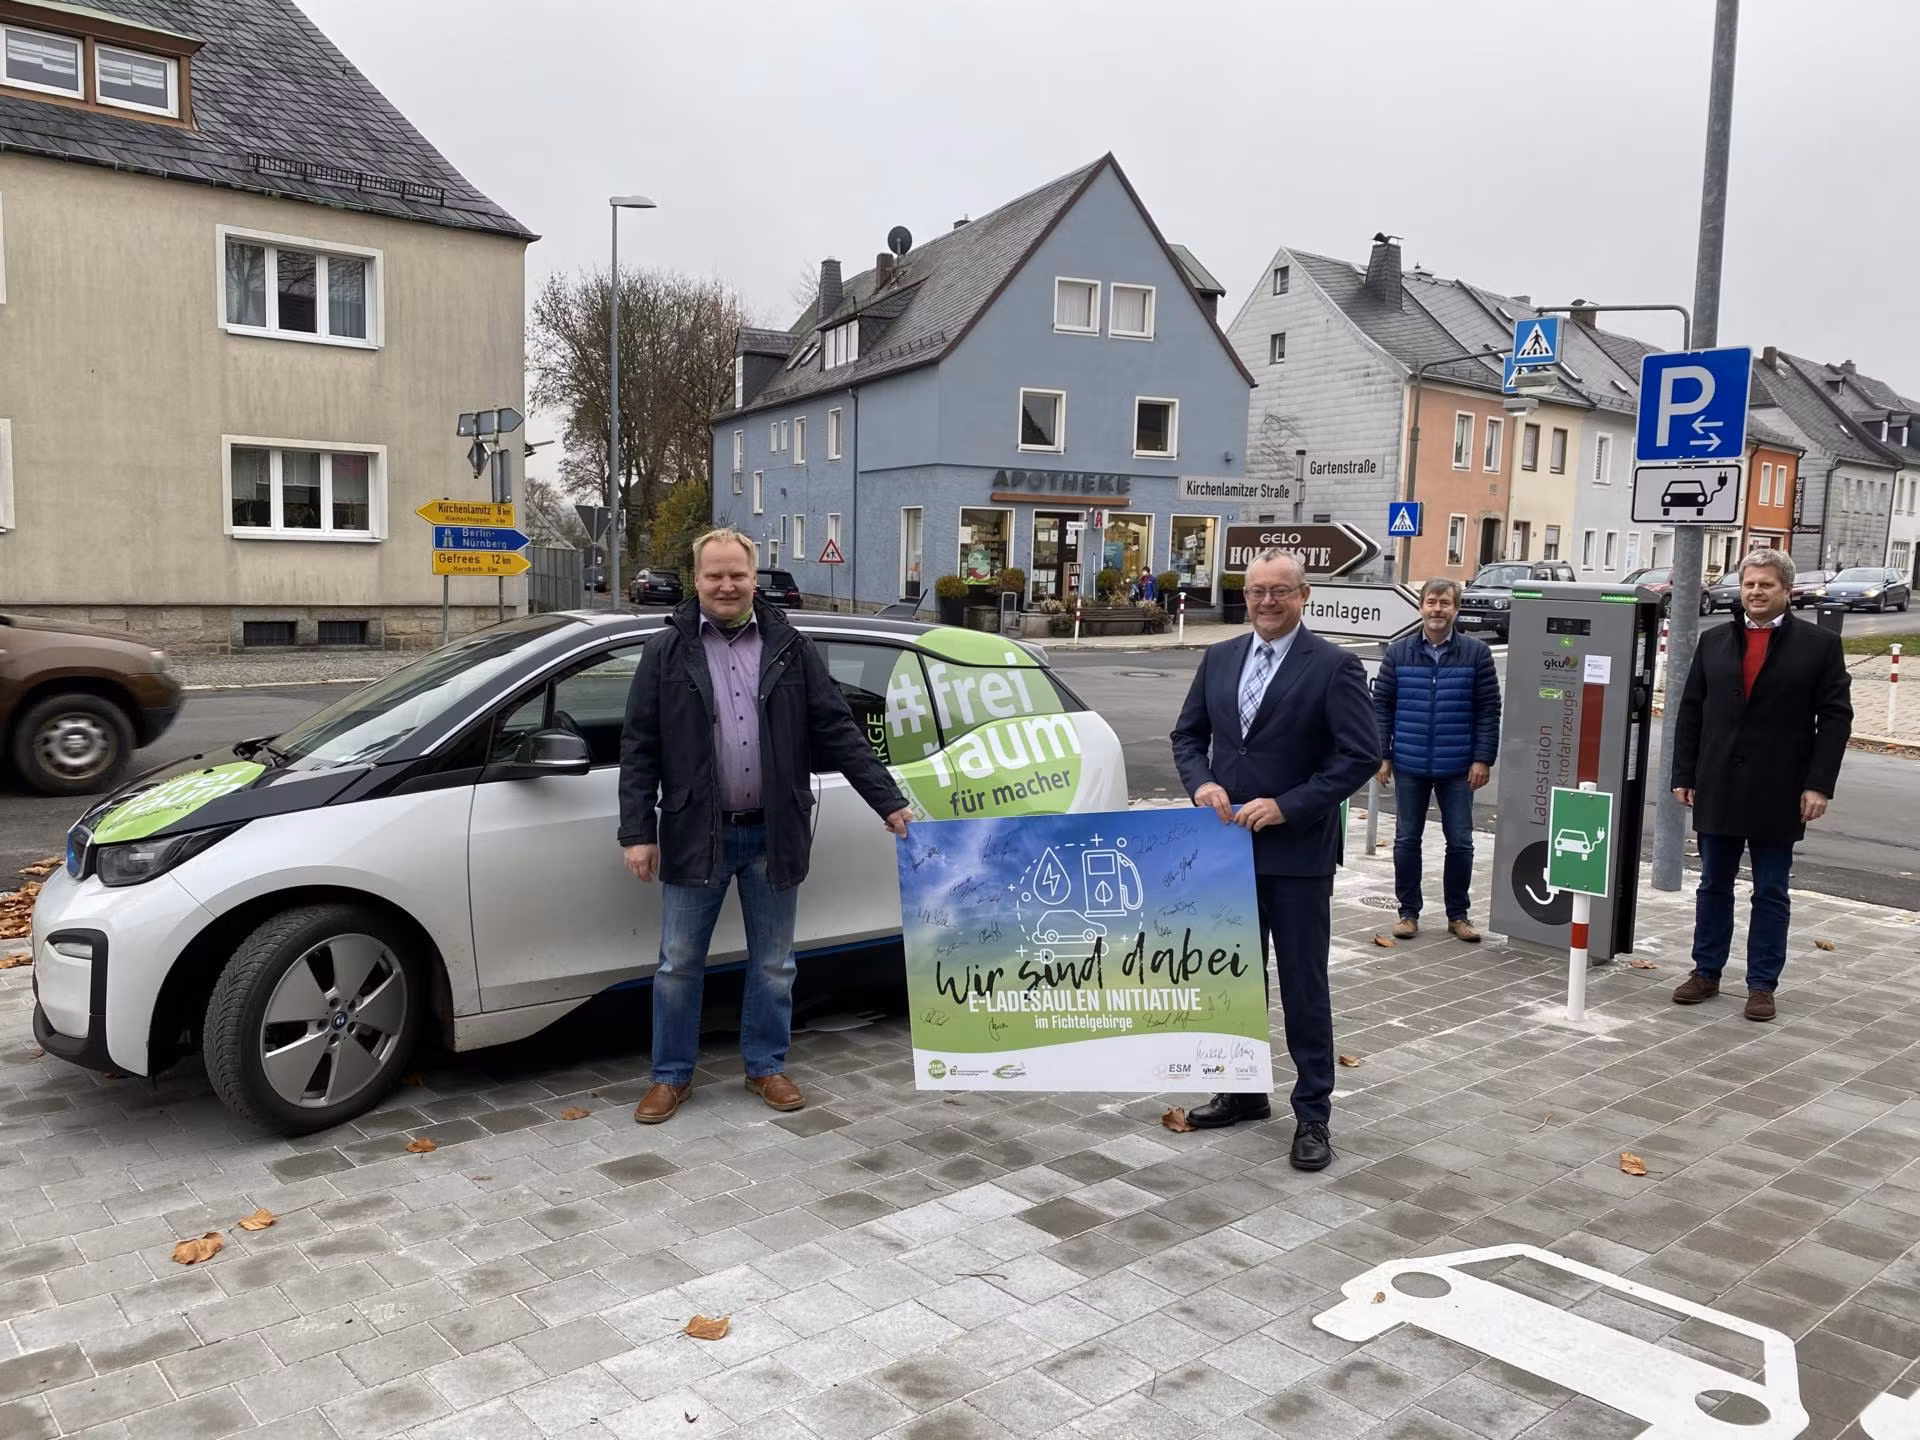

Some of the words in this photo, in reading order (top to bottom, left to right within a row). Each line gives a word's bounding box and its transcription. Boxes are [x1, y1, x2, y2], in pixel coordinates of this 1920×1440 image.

[1656, 365, 1716, 447] P
[1310, 458, 1376, 475] Gartenstraße
[992, 470, 1131, 494] APOTHEKE
[1186, 480, 1258, 498] Kirchenlamitzer
[1260, 485, 1290, 499] Straße
[438, 502, 492, 515] Kirchenlamitz
[502, 508, 512, 516] km
[462, 528, 496, 537] Berlin-
[463, 537, 507, 550] Nürnberg
[1260, 533, 1302, 544] GELO
[439, 554, 481, 564] Gefrees
[491, 555, 501, 565] 12
[502, 556, 512, 565] km
[1303, 600, 1381, 624] rtanlagen
[886, 652, 1034, 737] #frei
[1556, 689, 1578, 786] ktrofahrzeuge
[923, 713, 1082, 788] raum
[1530, 725, 1553, 826] Ladestation
[949, 789, 986, 817] für
[992, 769, 1072, 806] macher
[936, 961, 1004, 1005] Wir
[1018, 936, 1103, 1001] sind
[1122, 928, 1249, 985] dabei
[967, 985, 1100, 1013] E-LADESÄULEN
[1106, 988, 1203, 1012] INITIATIVE
[1035, 1014, 1049, 1029] im
[1051, 1013, 1133, 1032] Fichtelgebirge
[1168, 1064, 1192, 1073] ESM
